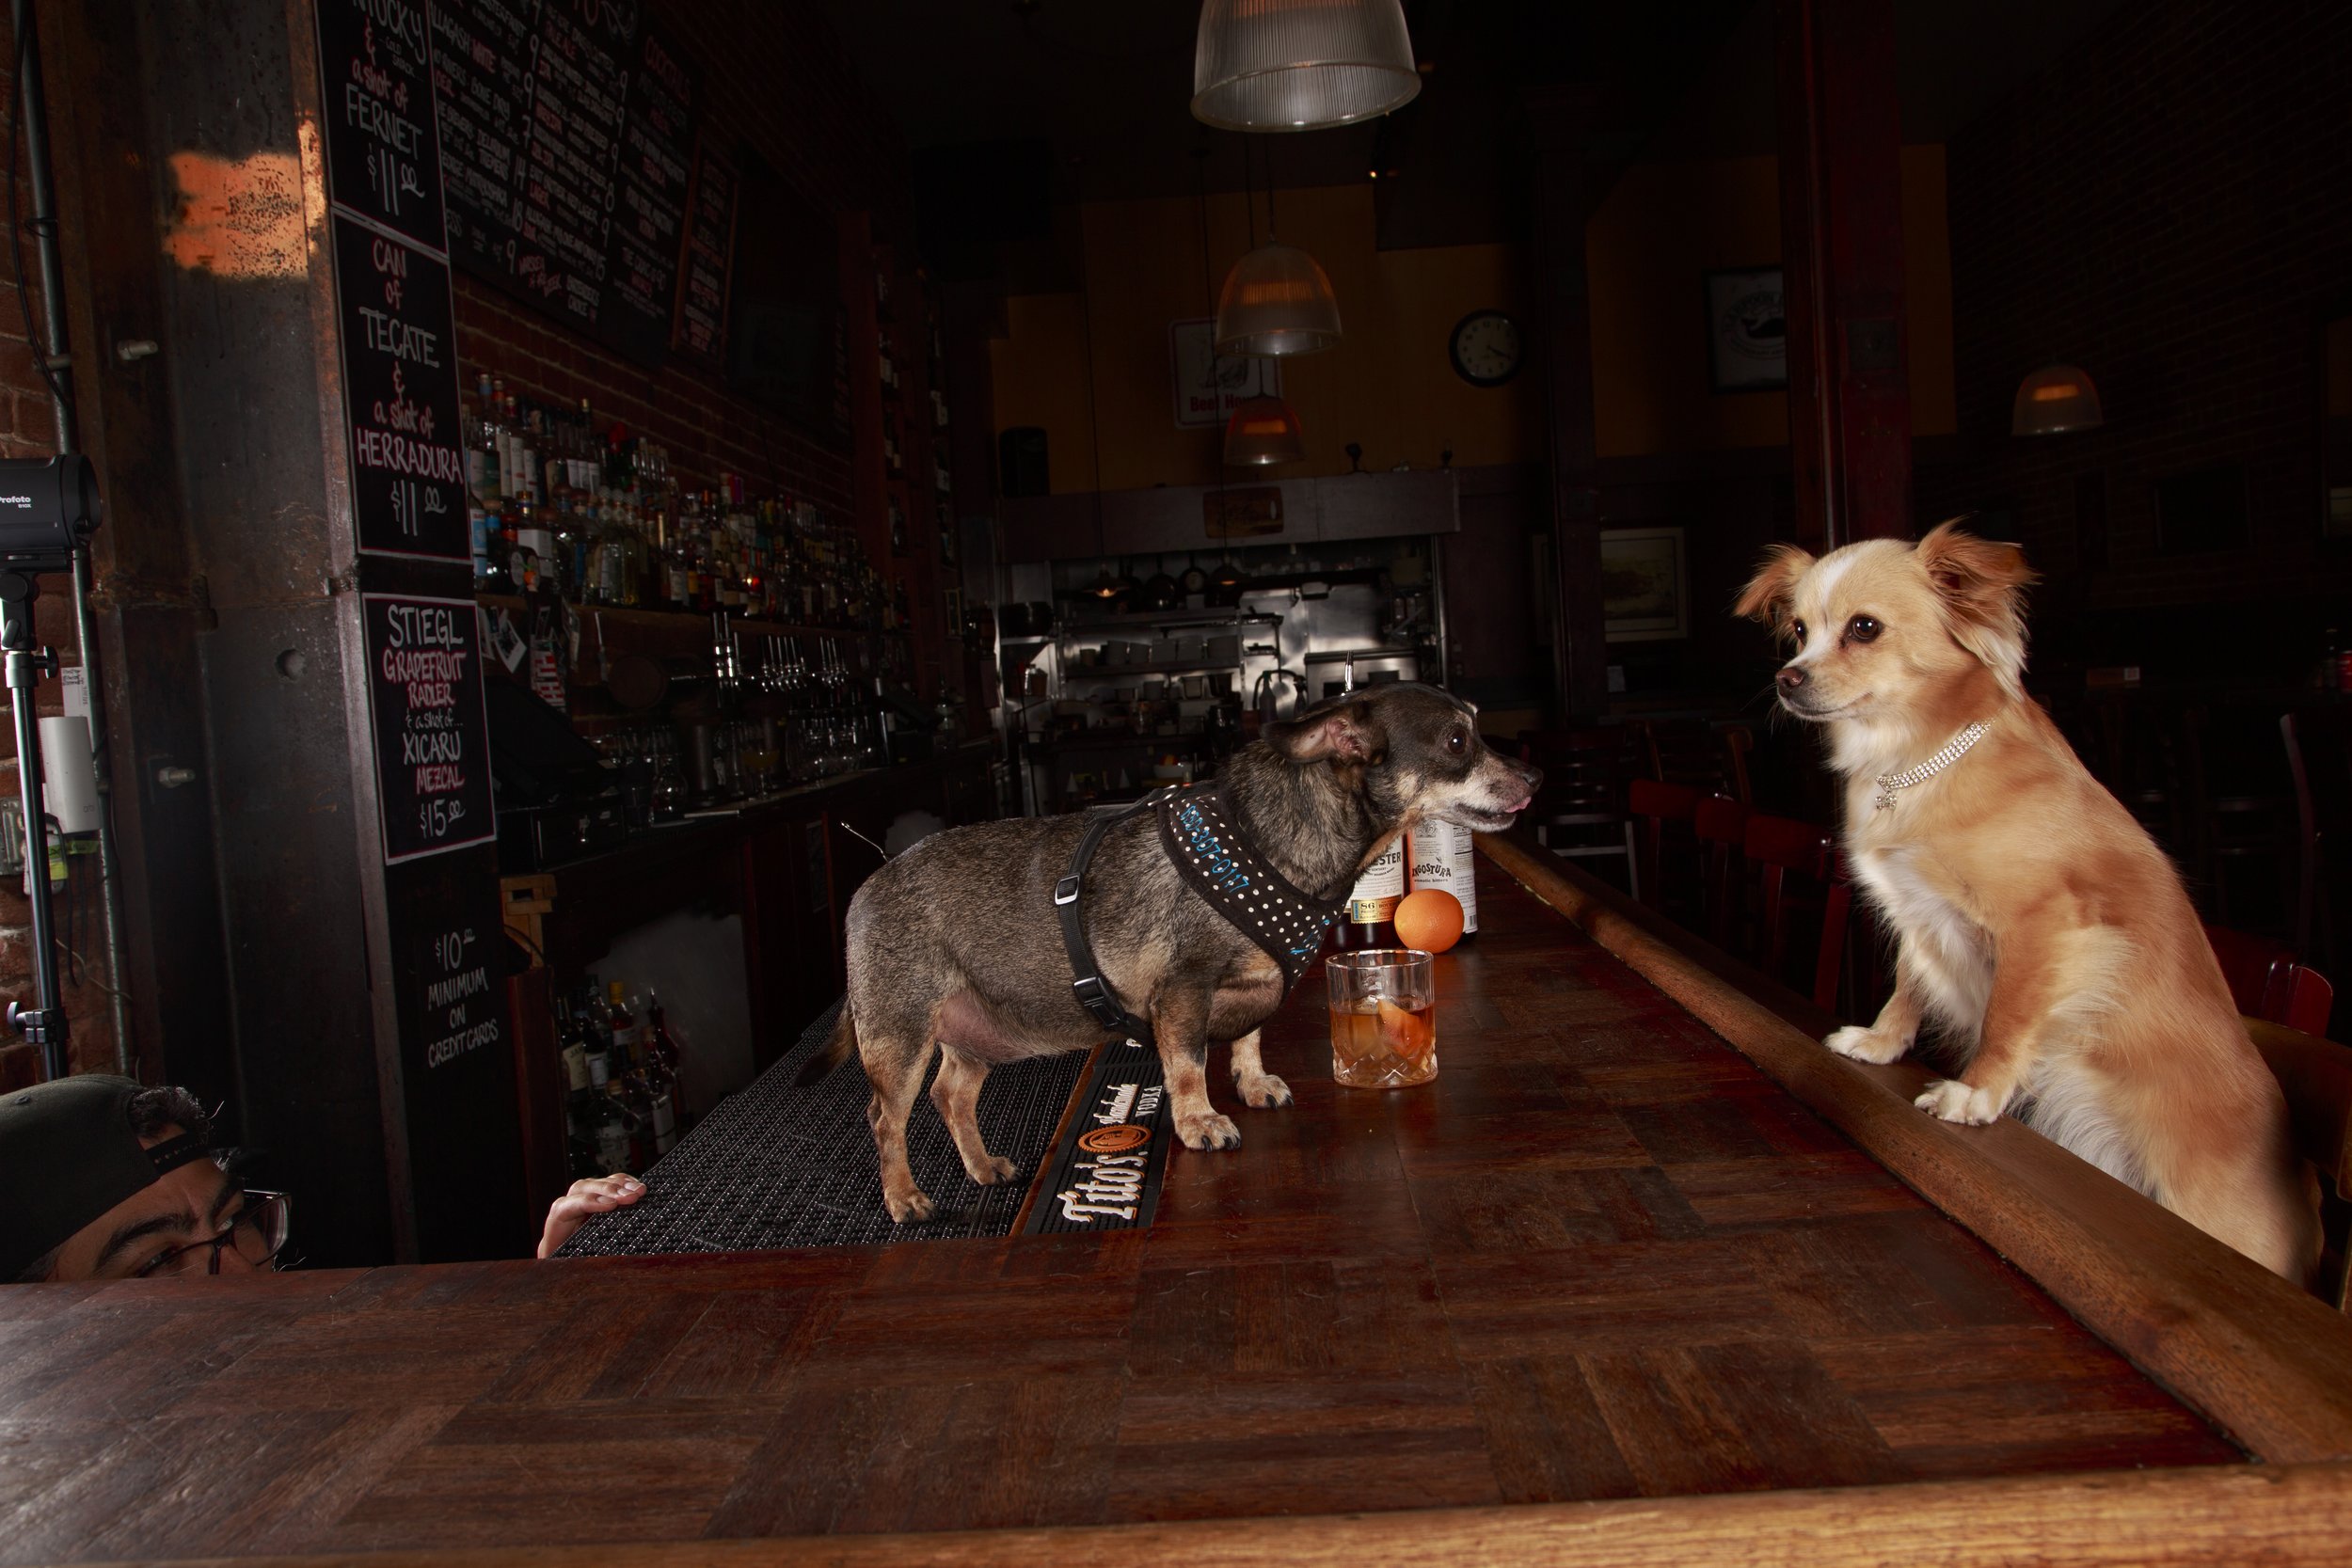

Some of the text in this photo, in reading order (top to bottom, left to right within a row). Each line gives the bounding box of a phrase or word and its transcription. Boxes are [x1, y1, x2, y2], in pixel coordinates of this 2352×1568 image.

[362, 64, 392, 101] shot
[394, 81, 409, 115] of
[523, 71, 534, 111] 9
[345, 82, 422, 161] FERNET
[373, 238, 406, 279] CAN
[505, 238, 517, 276] 9
[386, 278, 403, 311] of
[358, 306, 440, 369] TECATE
[373, 397, 435, 440] a shot of
[356, 426, 464, 485] HERRADURA
[387, 603, 464, 651] STIEGL
[382, 646, 468, 686] GRAPEFRUIT
[407, 680, 456, 712] RADLER
[415, 713, 424, 731] a
[423, 707, 444, 730] shot
[402, 729, 463, 767] XICARU
[416, 765, 466, 796] MEZCAL
[1360, 901, 1375, 910] 86
[427, 966, 489, 1012] MINIMUM
[449, 1003, 467, 1030] ON
[427, 1017, 500, 1069] CREDIT CARDS
[1135, 1085, 1163, 1117] VODKA
[1057, 1150, 1151, 1223] Tito's
